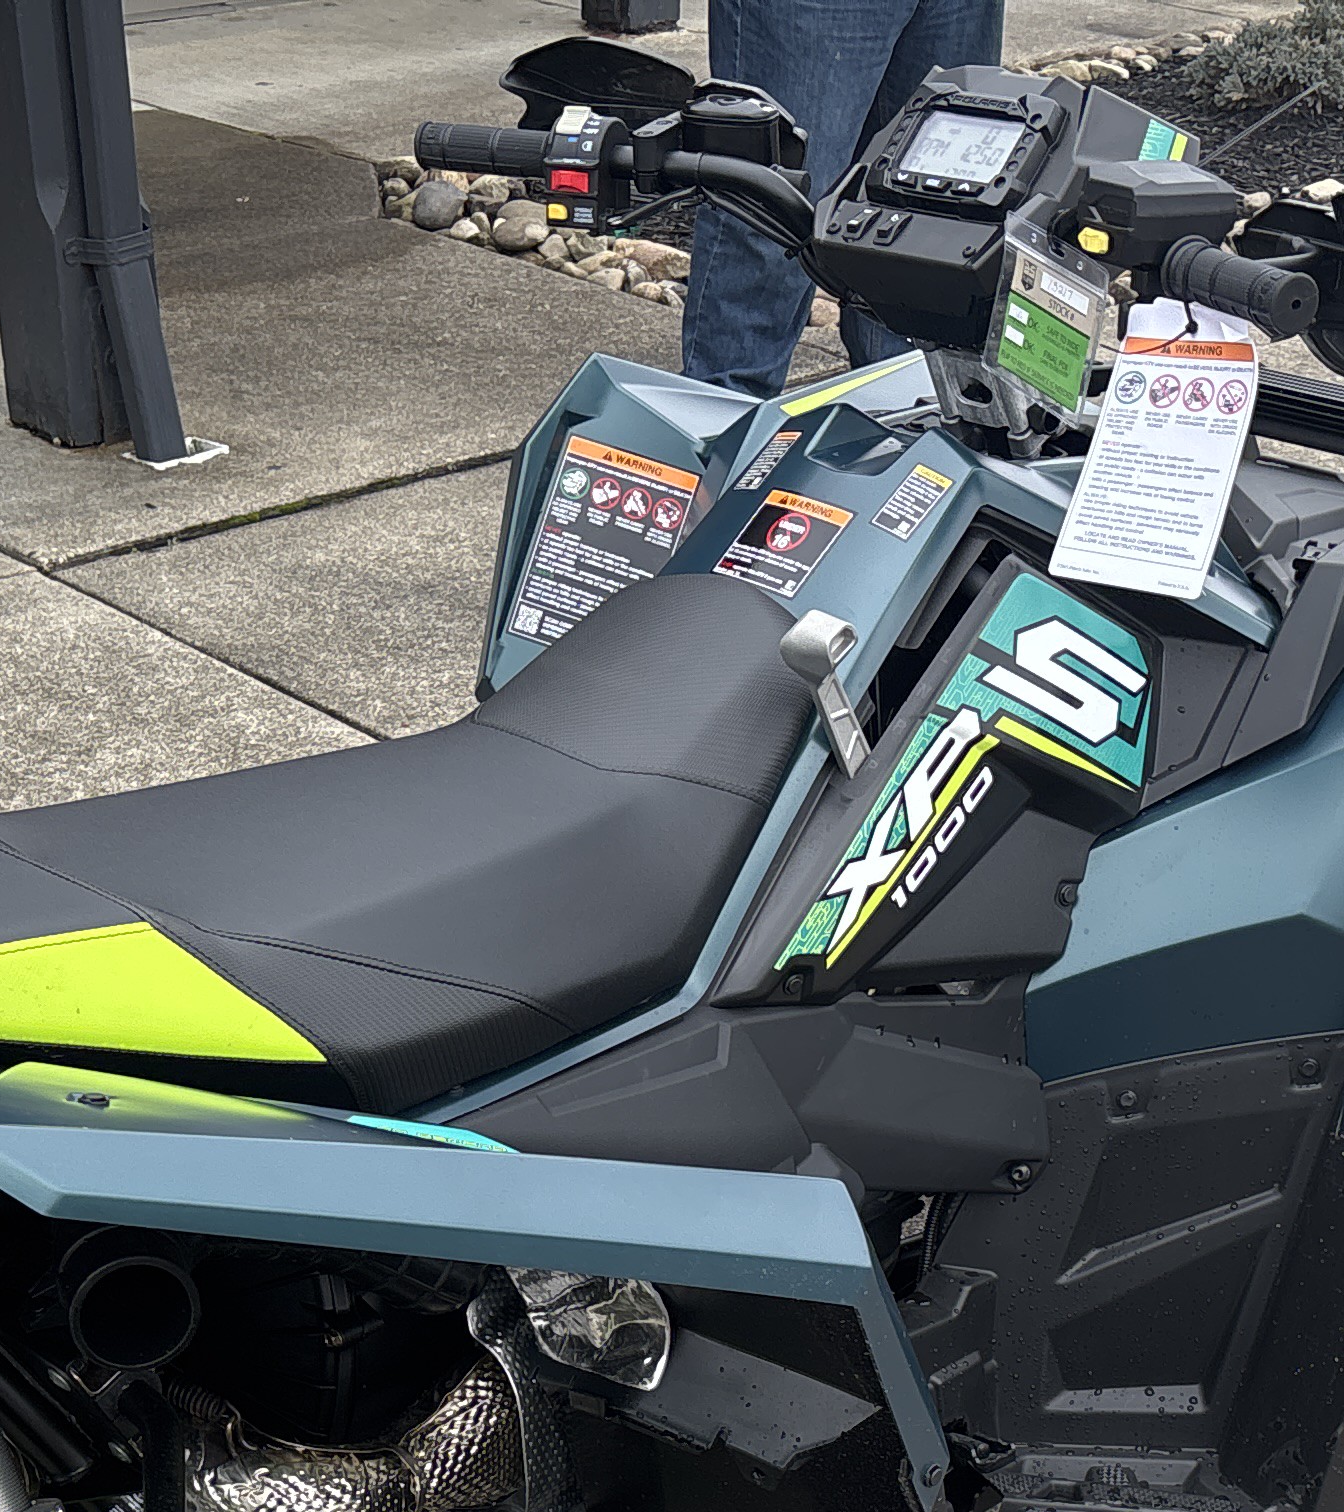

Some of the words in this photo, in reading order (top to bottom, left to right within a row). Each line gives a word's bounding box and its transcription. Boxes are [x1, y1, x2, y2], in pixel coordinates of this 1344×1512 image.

[960, 143, 1005, 167] 1250
[1175, 343, 1223, 357] WARNING
[615, 454, 663, 478] WARNING
[787, 497, 834, 520] WARNING
[771, 534, 792, 550] 16
[826, 707, 982, 954] XP
[982, 618, 1149, 745] S
[890, 766, 994, 908] 1000
